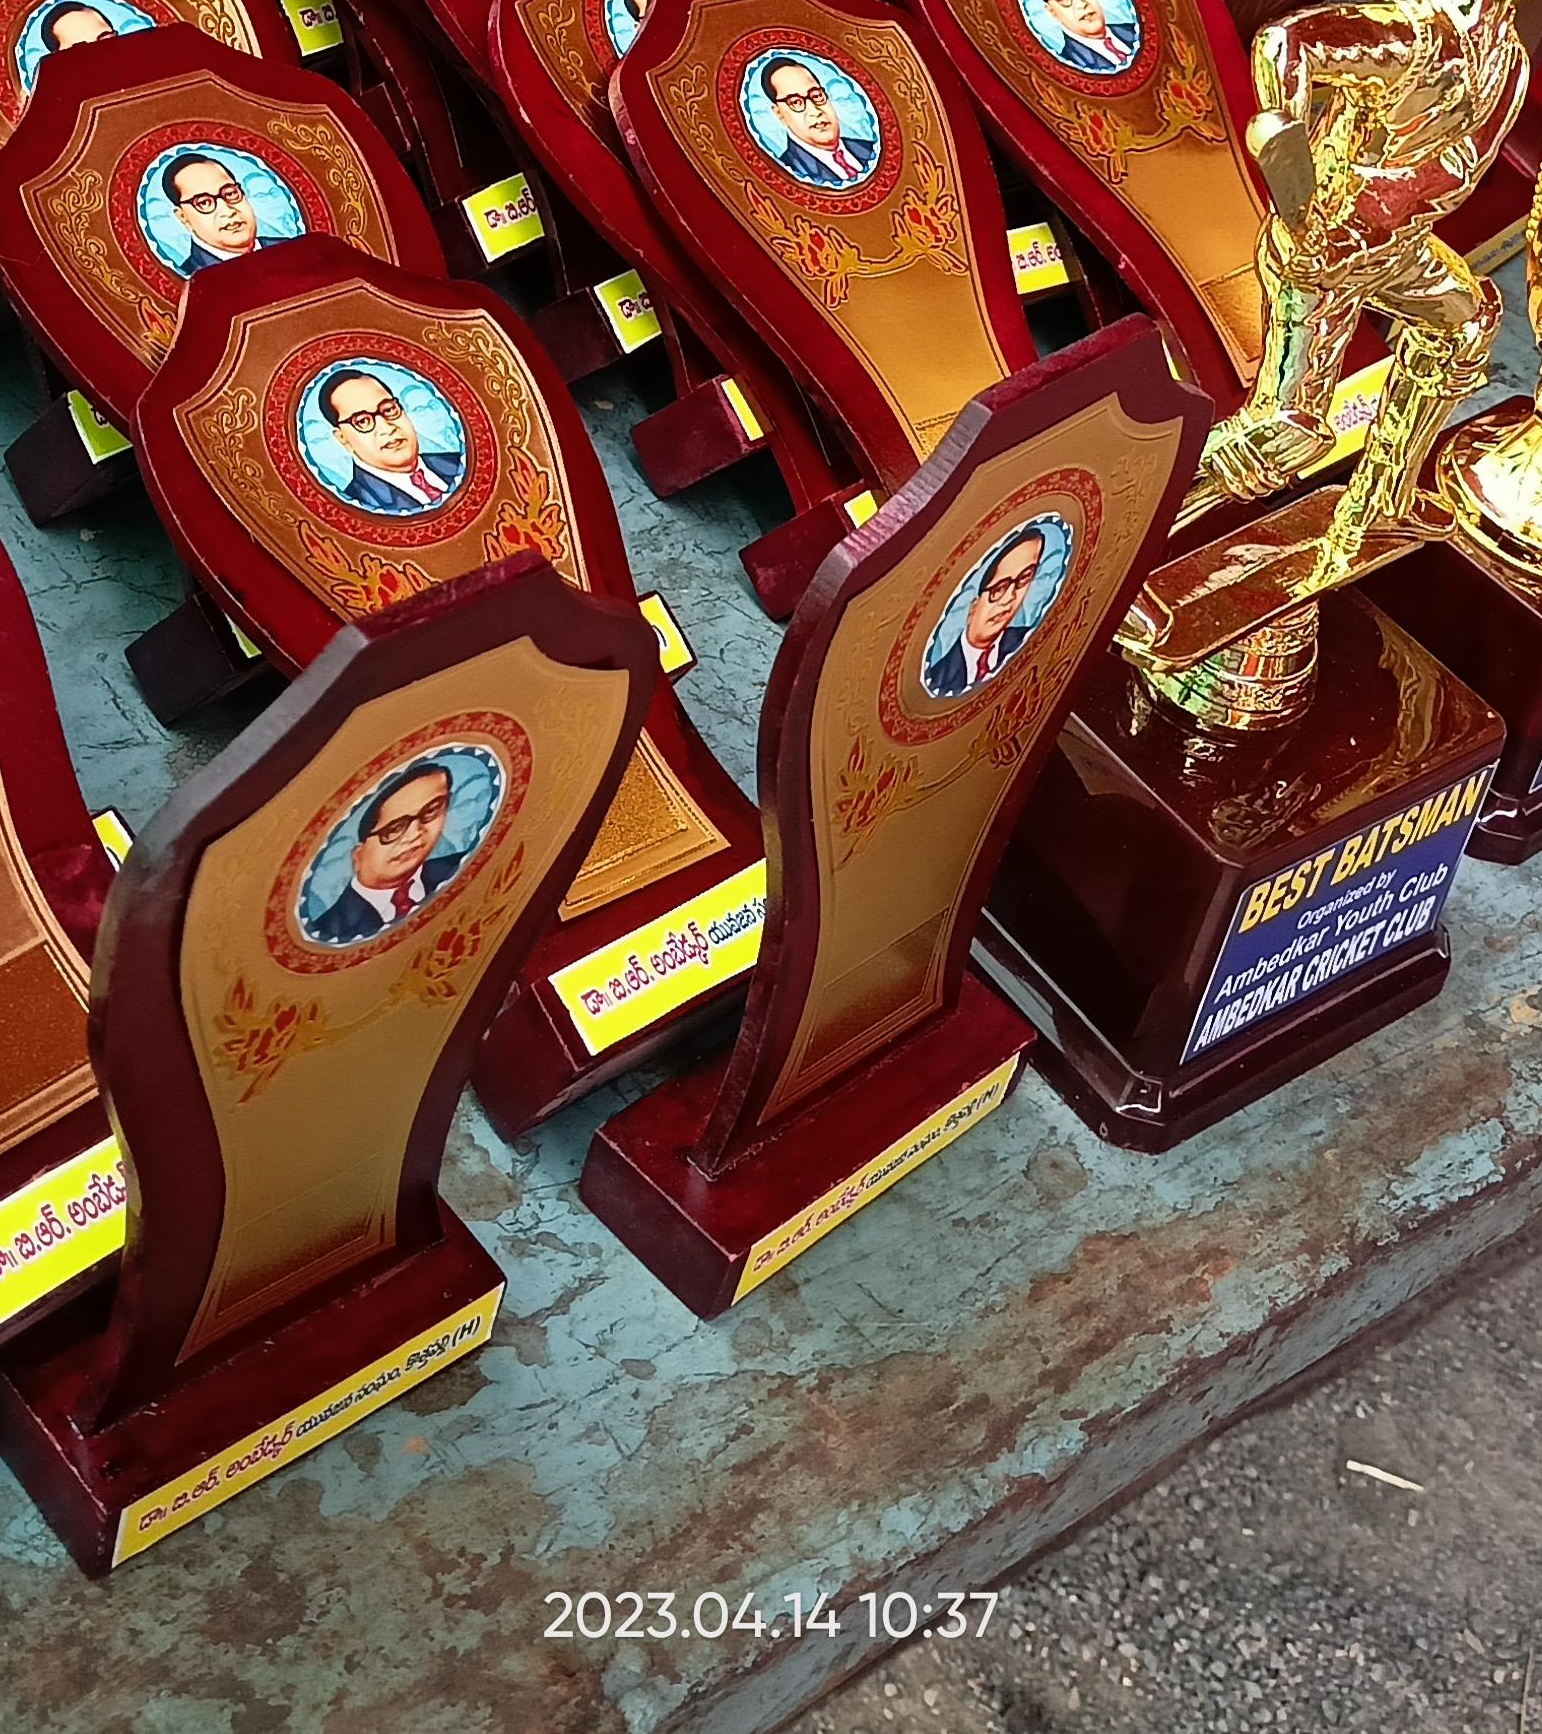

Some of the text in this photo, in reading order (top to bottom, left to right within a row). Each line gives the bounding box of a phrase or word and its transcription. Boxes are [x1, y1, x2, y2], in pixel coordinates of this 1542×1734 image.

[1239, 771, 1488, 934] BEST BATSMAN
[1297, 868, 1397, 930] Organized by
[1194, 896, 1434, 1052] AMBEDKAR CRICKET CLUB
[1214, 863, 1448, 1005] Ambedkar Youth Club
